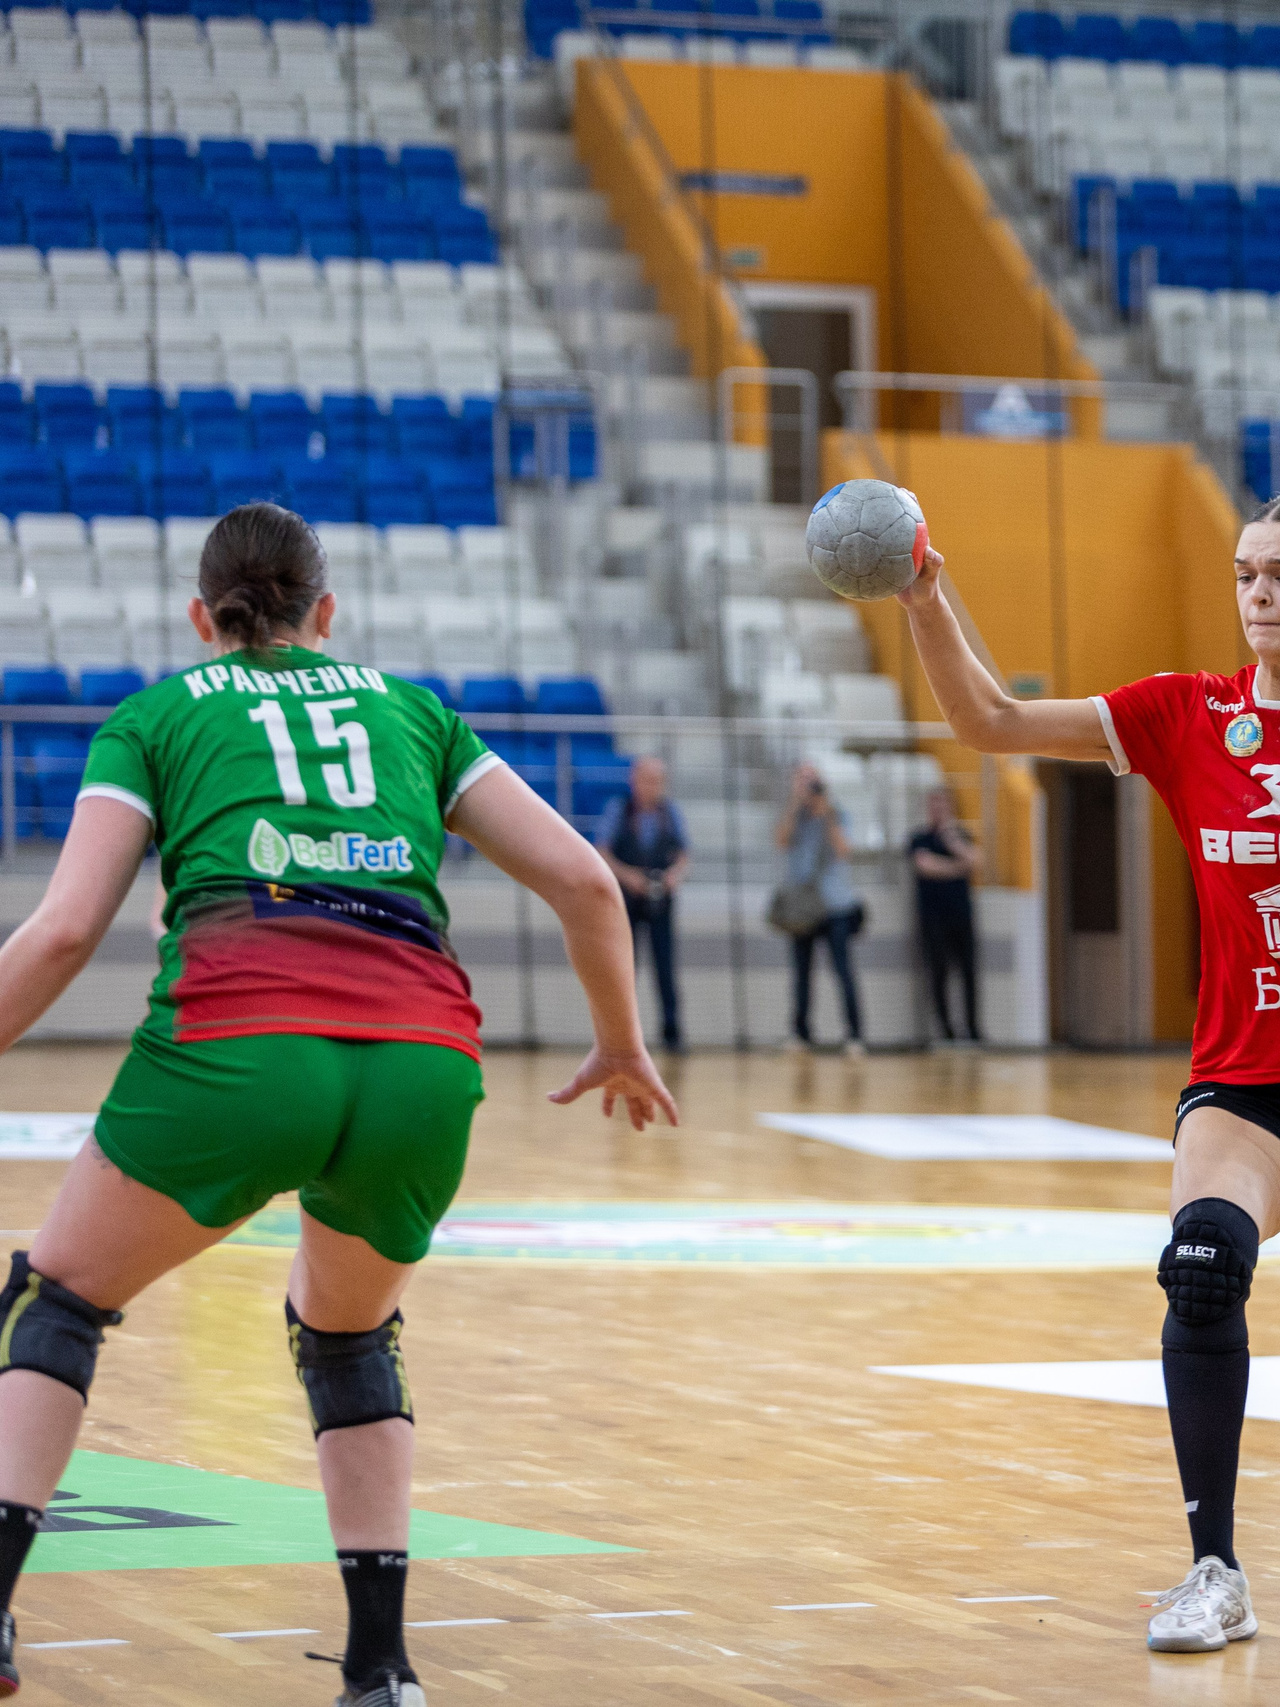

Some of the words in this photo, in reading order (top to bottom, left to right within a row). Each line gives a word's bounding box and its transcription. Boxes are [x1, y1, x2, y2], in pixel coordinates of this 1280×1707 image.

[183, 664, 388, 699] КРАВЧЕНКО
[1205, 695, 1246, 714] Kemp
[248, 697, 376, 807] 15
[289, 833, 412, 871] BelFert
[1176, 1245, 1217, 1259] SELECT
